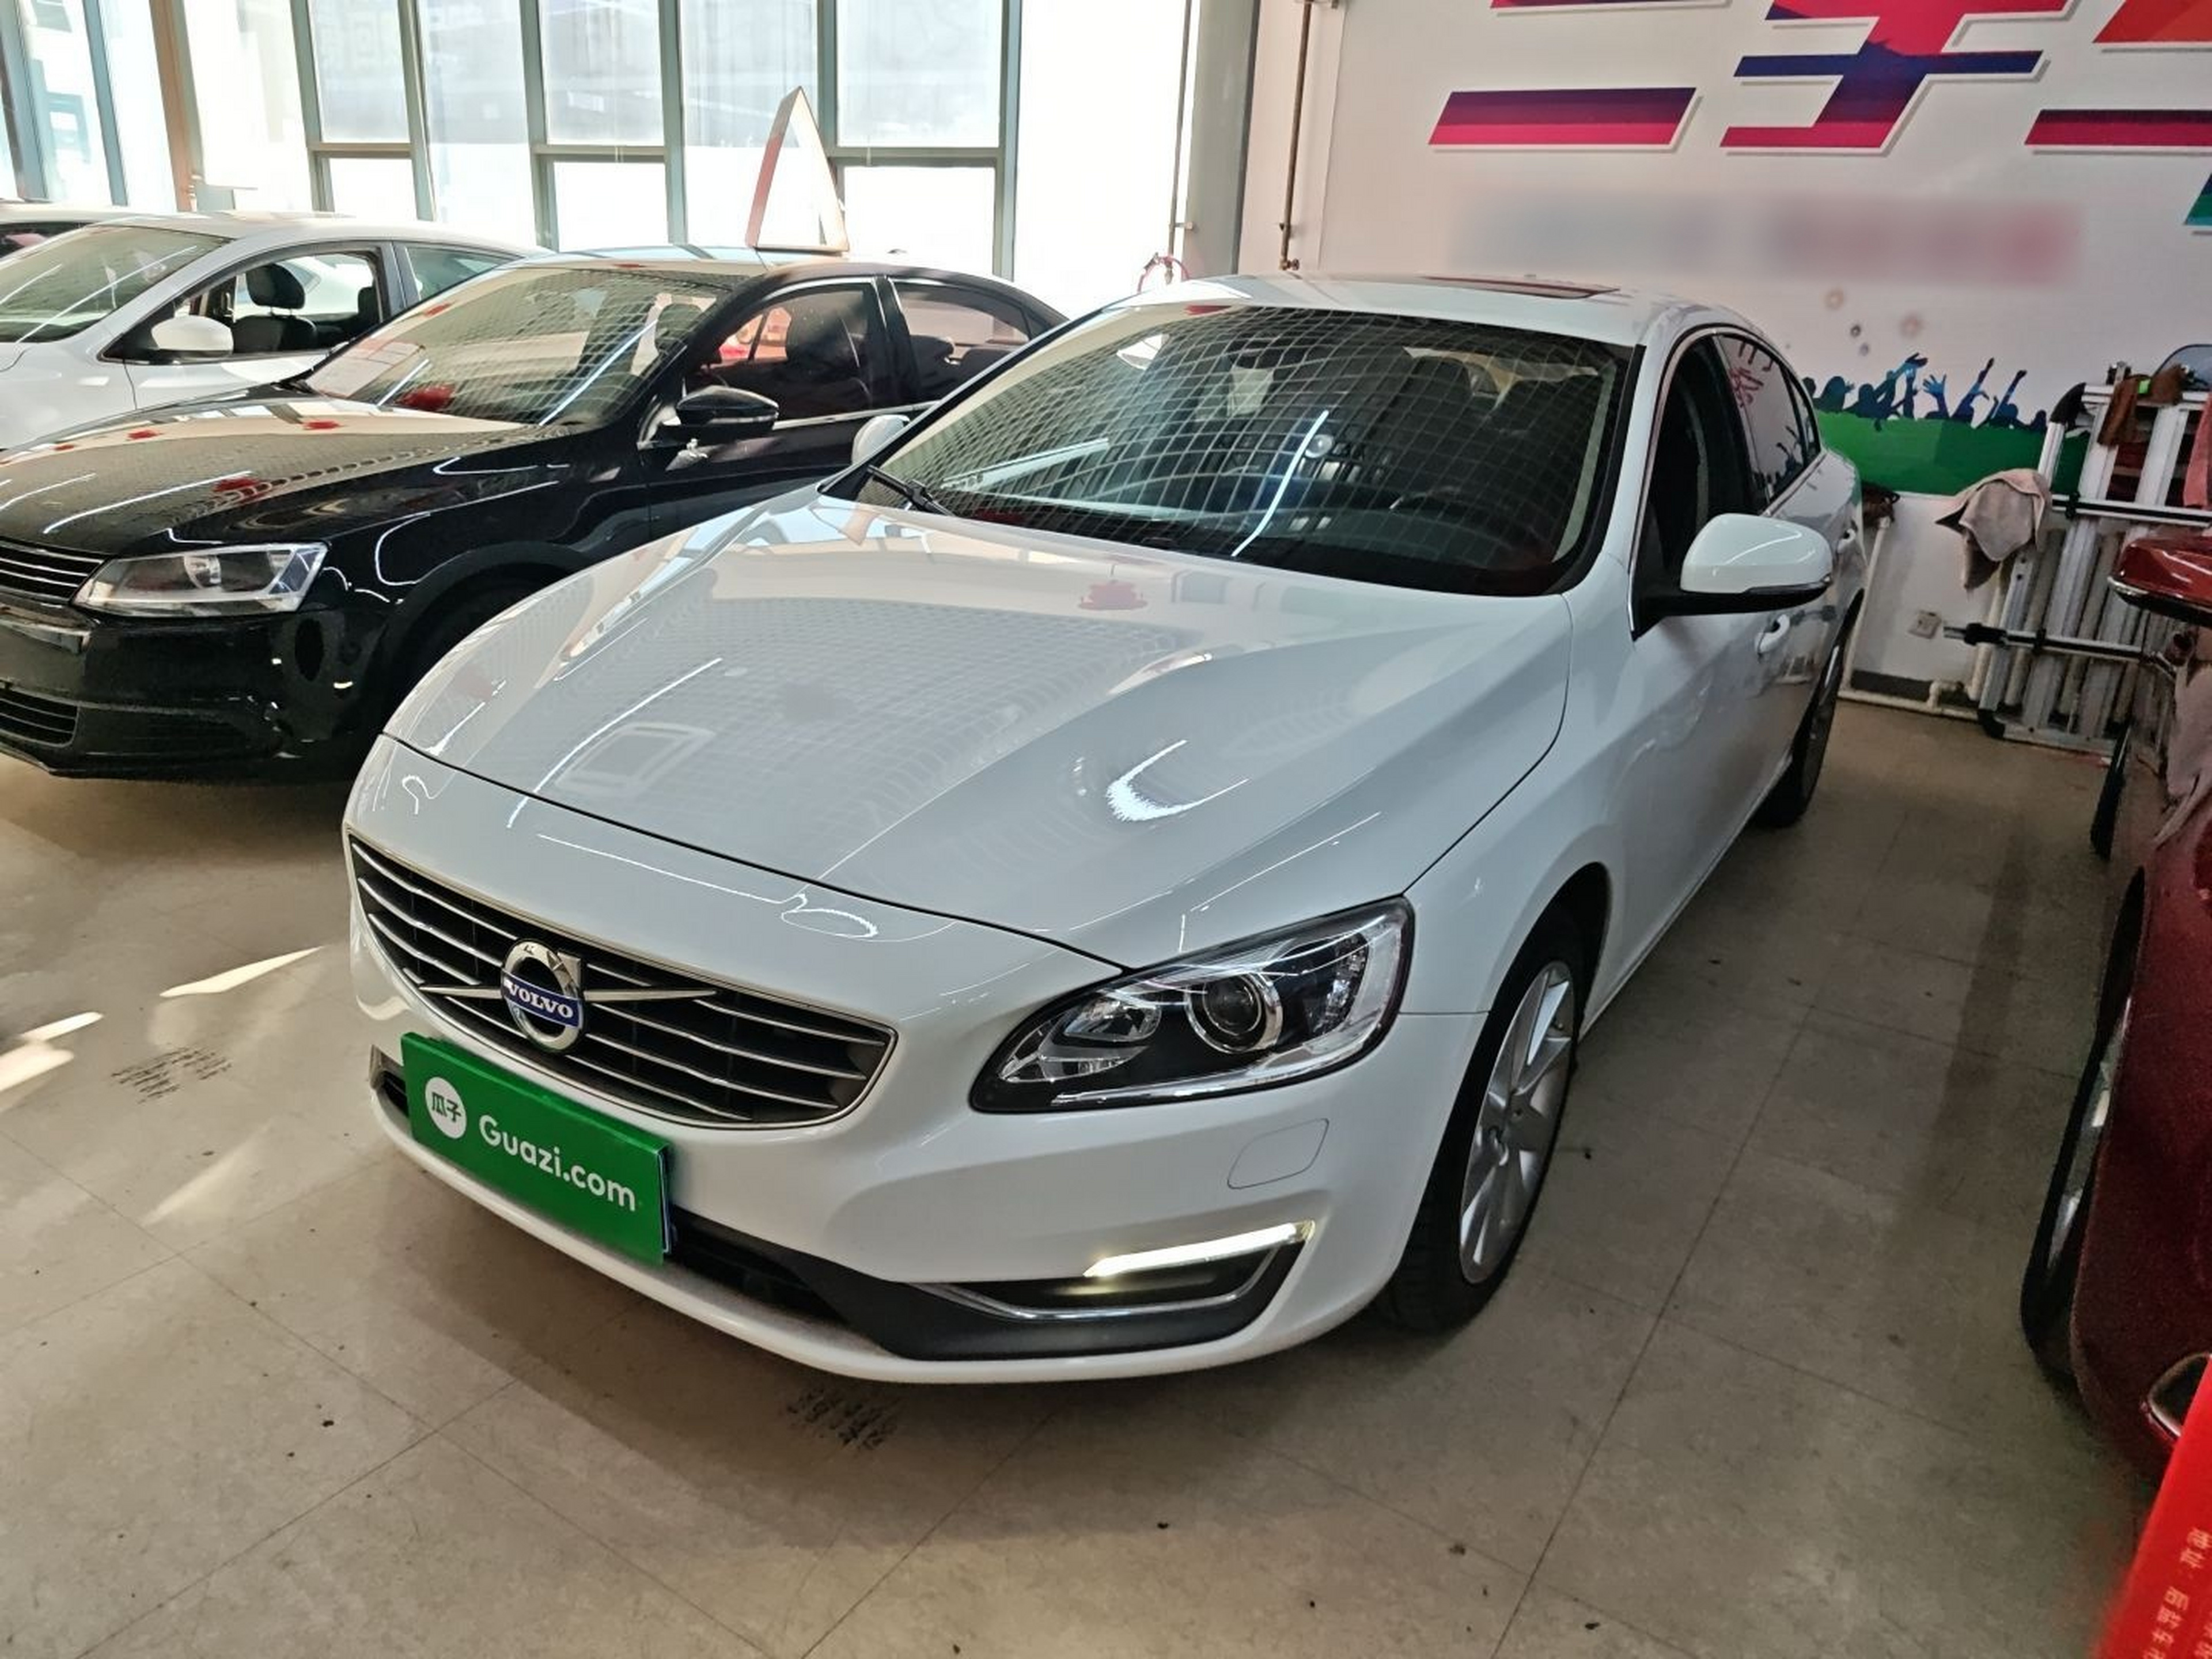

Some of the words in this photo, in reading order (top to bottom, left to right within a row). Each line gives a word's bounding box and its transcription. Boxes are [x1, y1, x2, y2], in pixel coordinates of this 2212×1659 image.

[503, 977, 574, 1018] VOLVO
[432, 1092, 462, 1123] 瓜子
[479, 1115, 635, 1211] Guazi.com
